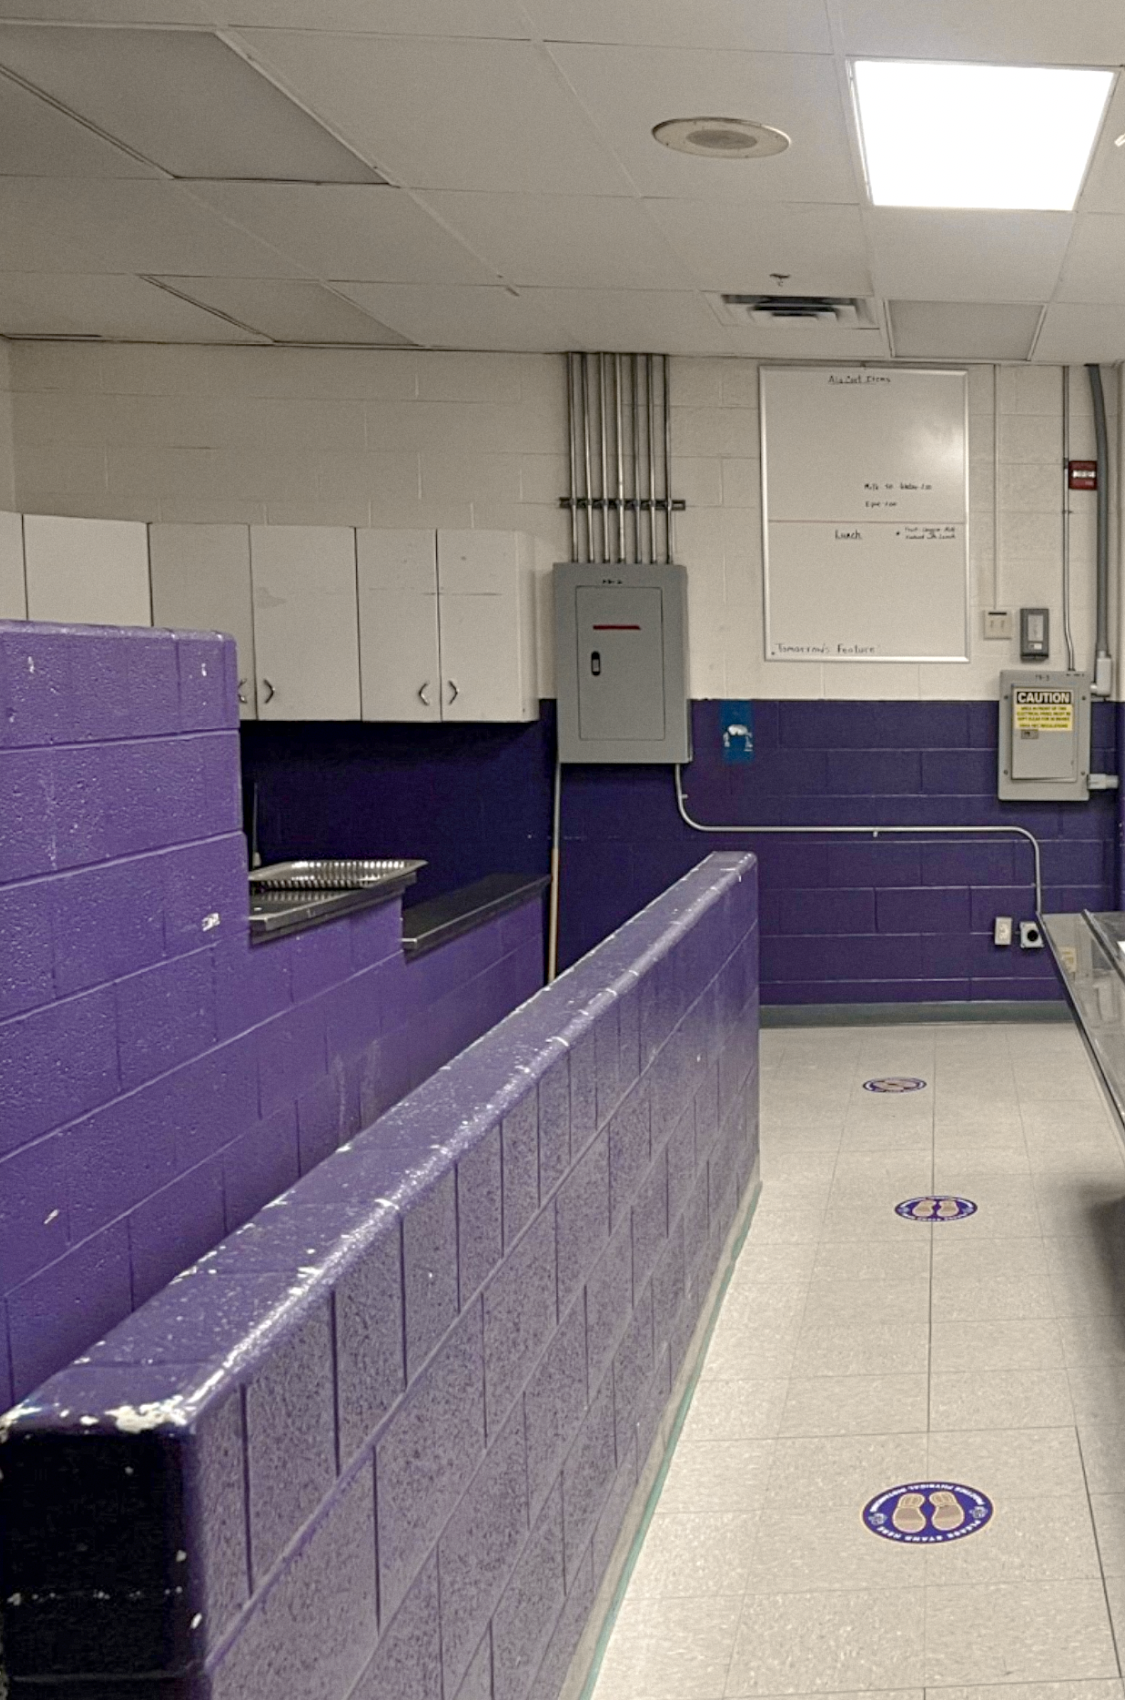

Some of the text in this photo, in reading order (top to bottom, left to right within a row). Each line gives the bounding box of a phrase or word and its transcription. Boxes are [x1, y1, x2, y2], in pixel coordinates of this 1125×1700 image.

[834, 529, 863, 540] Lunch
[1018, 692, 1070, 704] CAUTION
[876, 1519, 981, 1542] PLEASE STAND HERE
